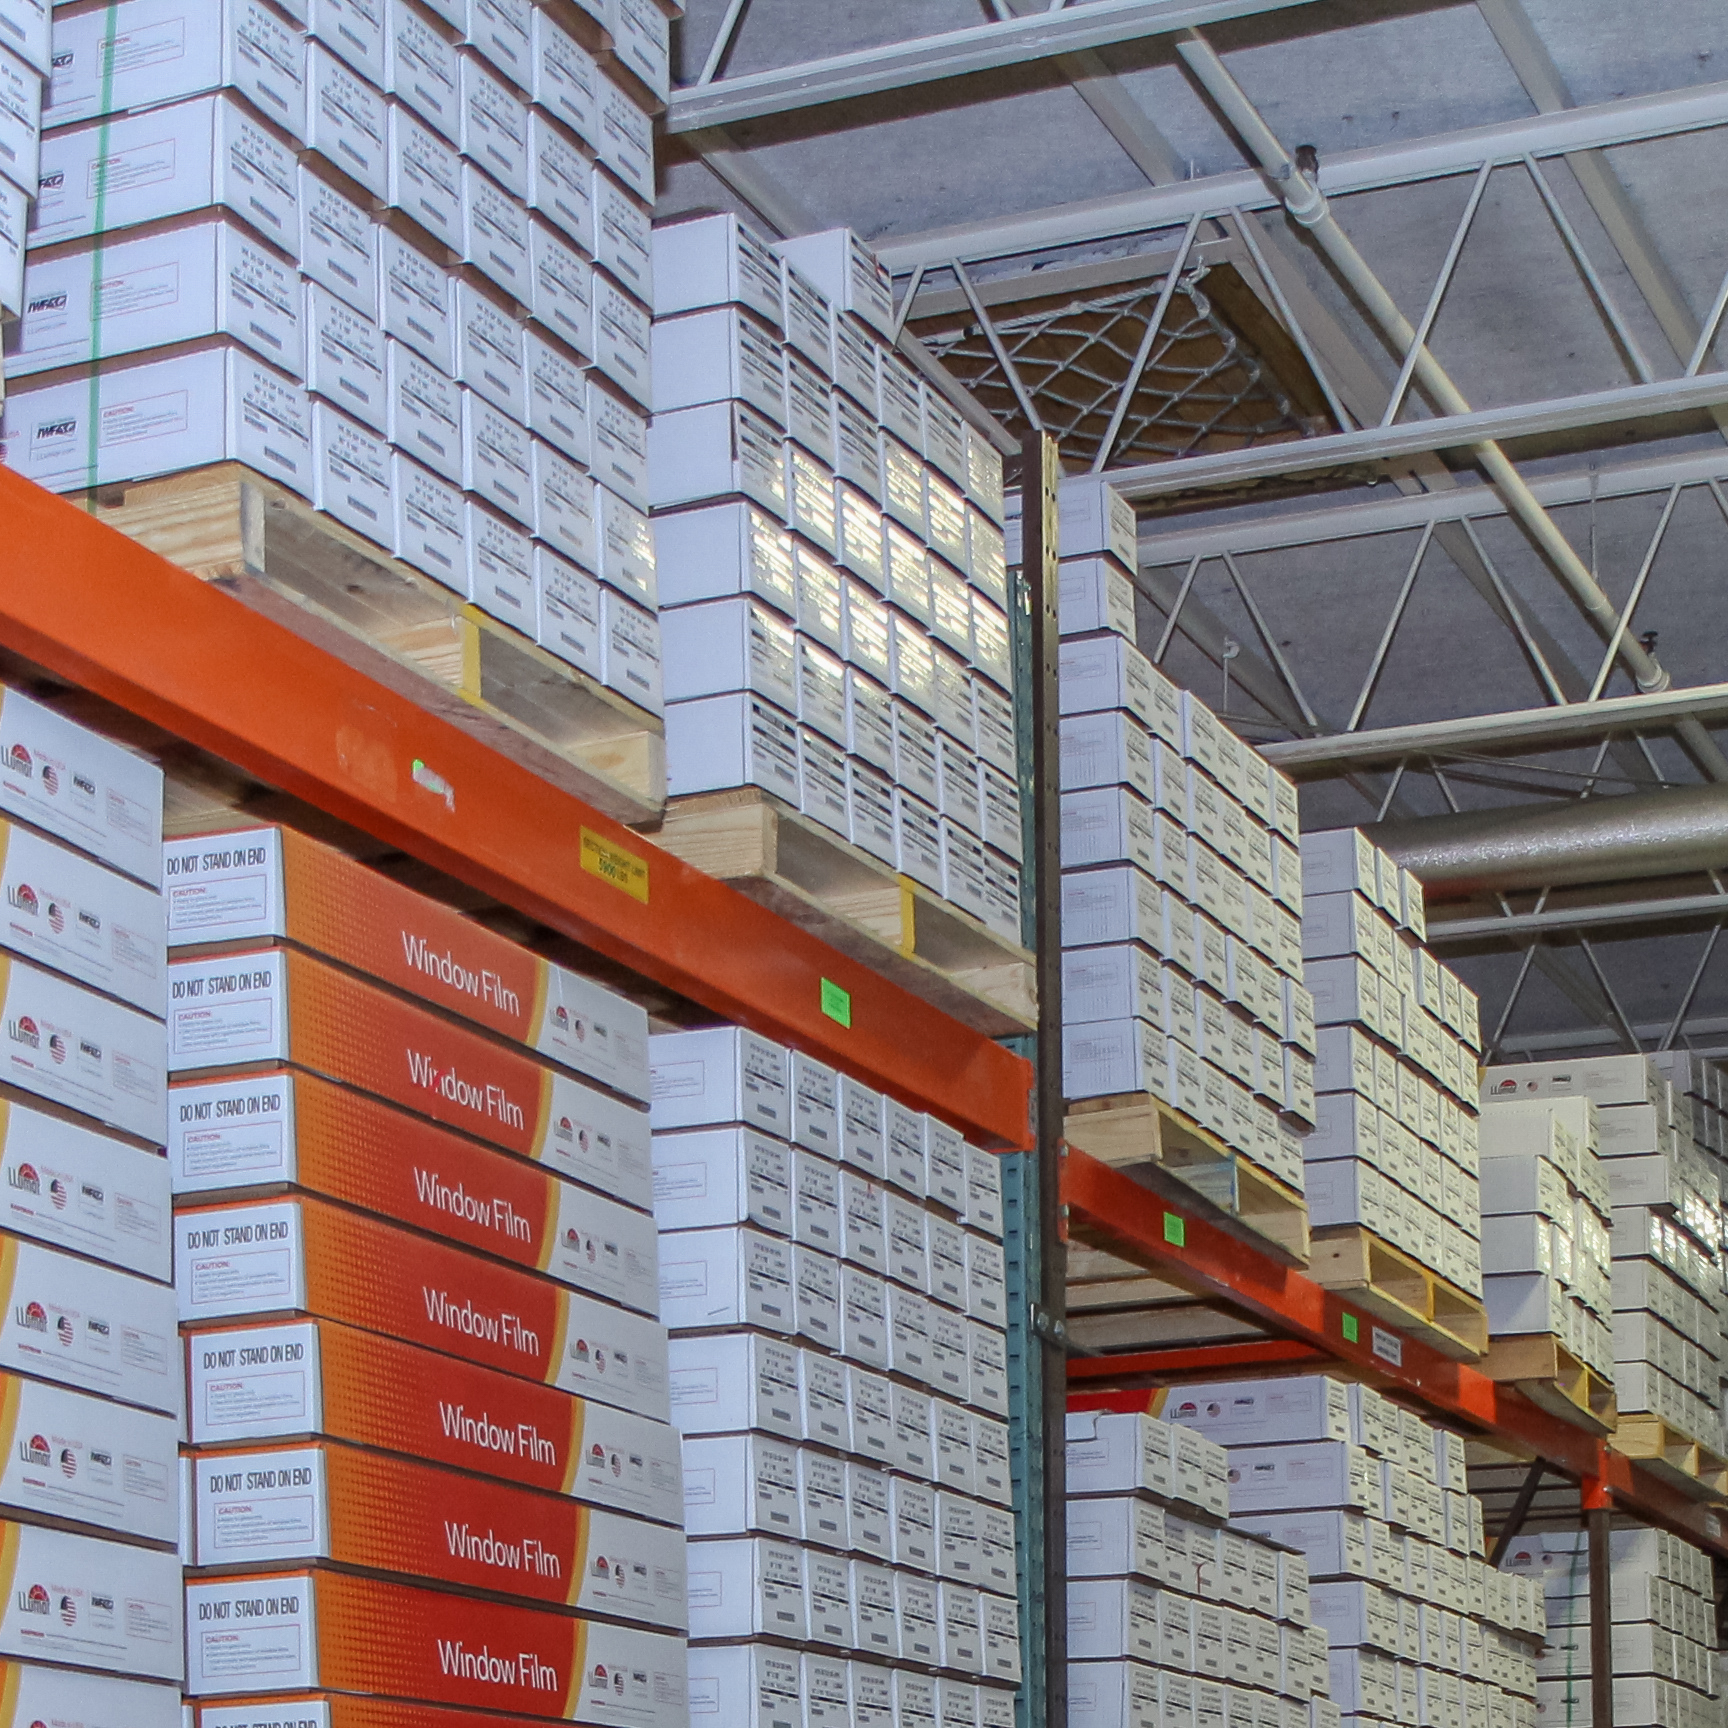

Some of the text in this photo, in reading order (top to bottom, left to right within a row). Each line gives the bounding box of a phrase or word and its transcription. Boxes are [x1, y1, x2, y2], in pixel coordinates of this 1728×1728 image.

[402, 931, 519, 1017] Window Film
[487, 1085, 523, 1130] Film
[414, 1167, 530, 1243] Window Film
[423, 1286, 538, 1356] Window Film
[440, 1402, 555, 1465] Window Film
[445, 1521, 560, 1578] Window Film
[438, 1640, 557, 1691] Window Film
